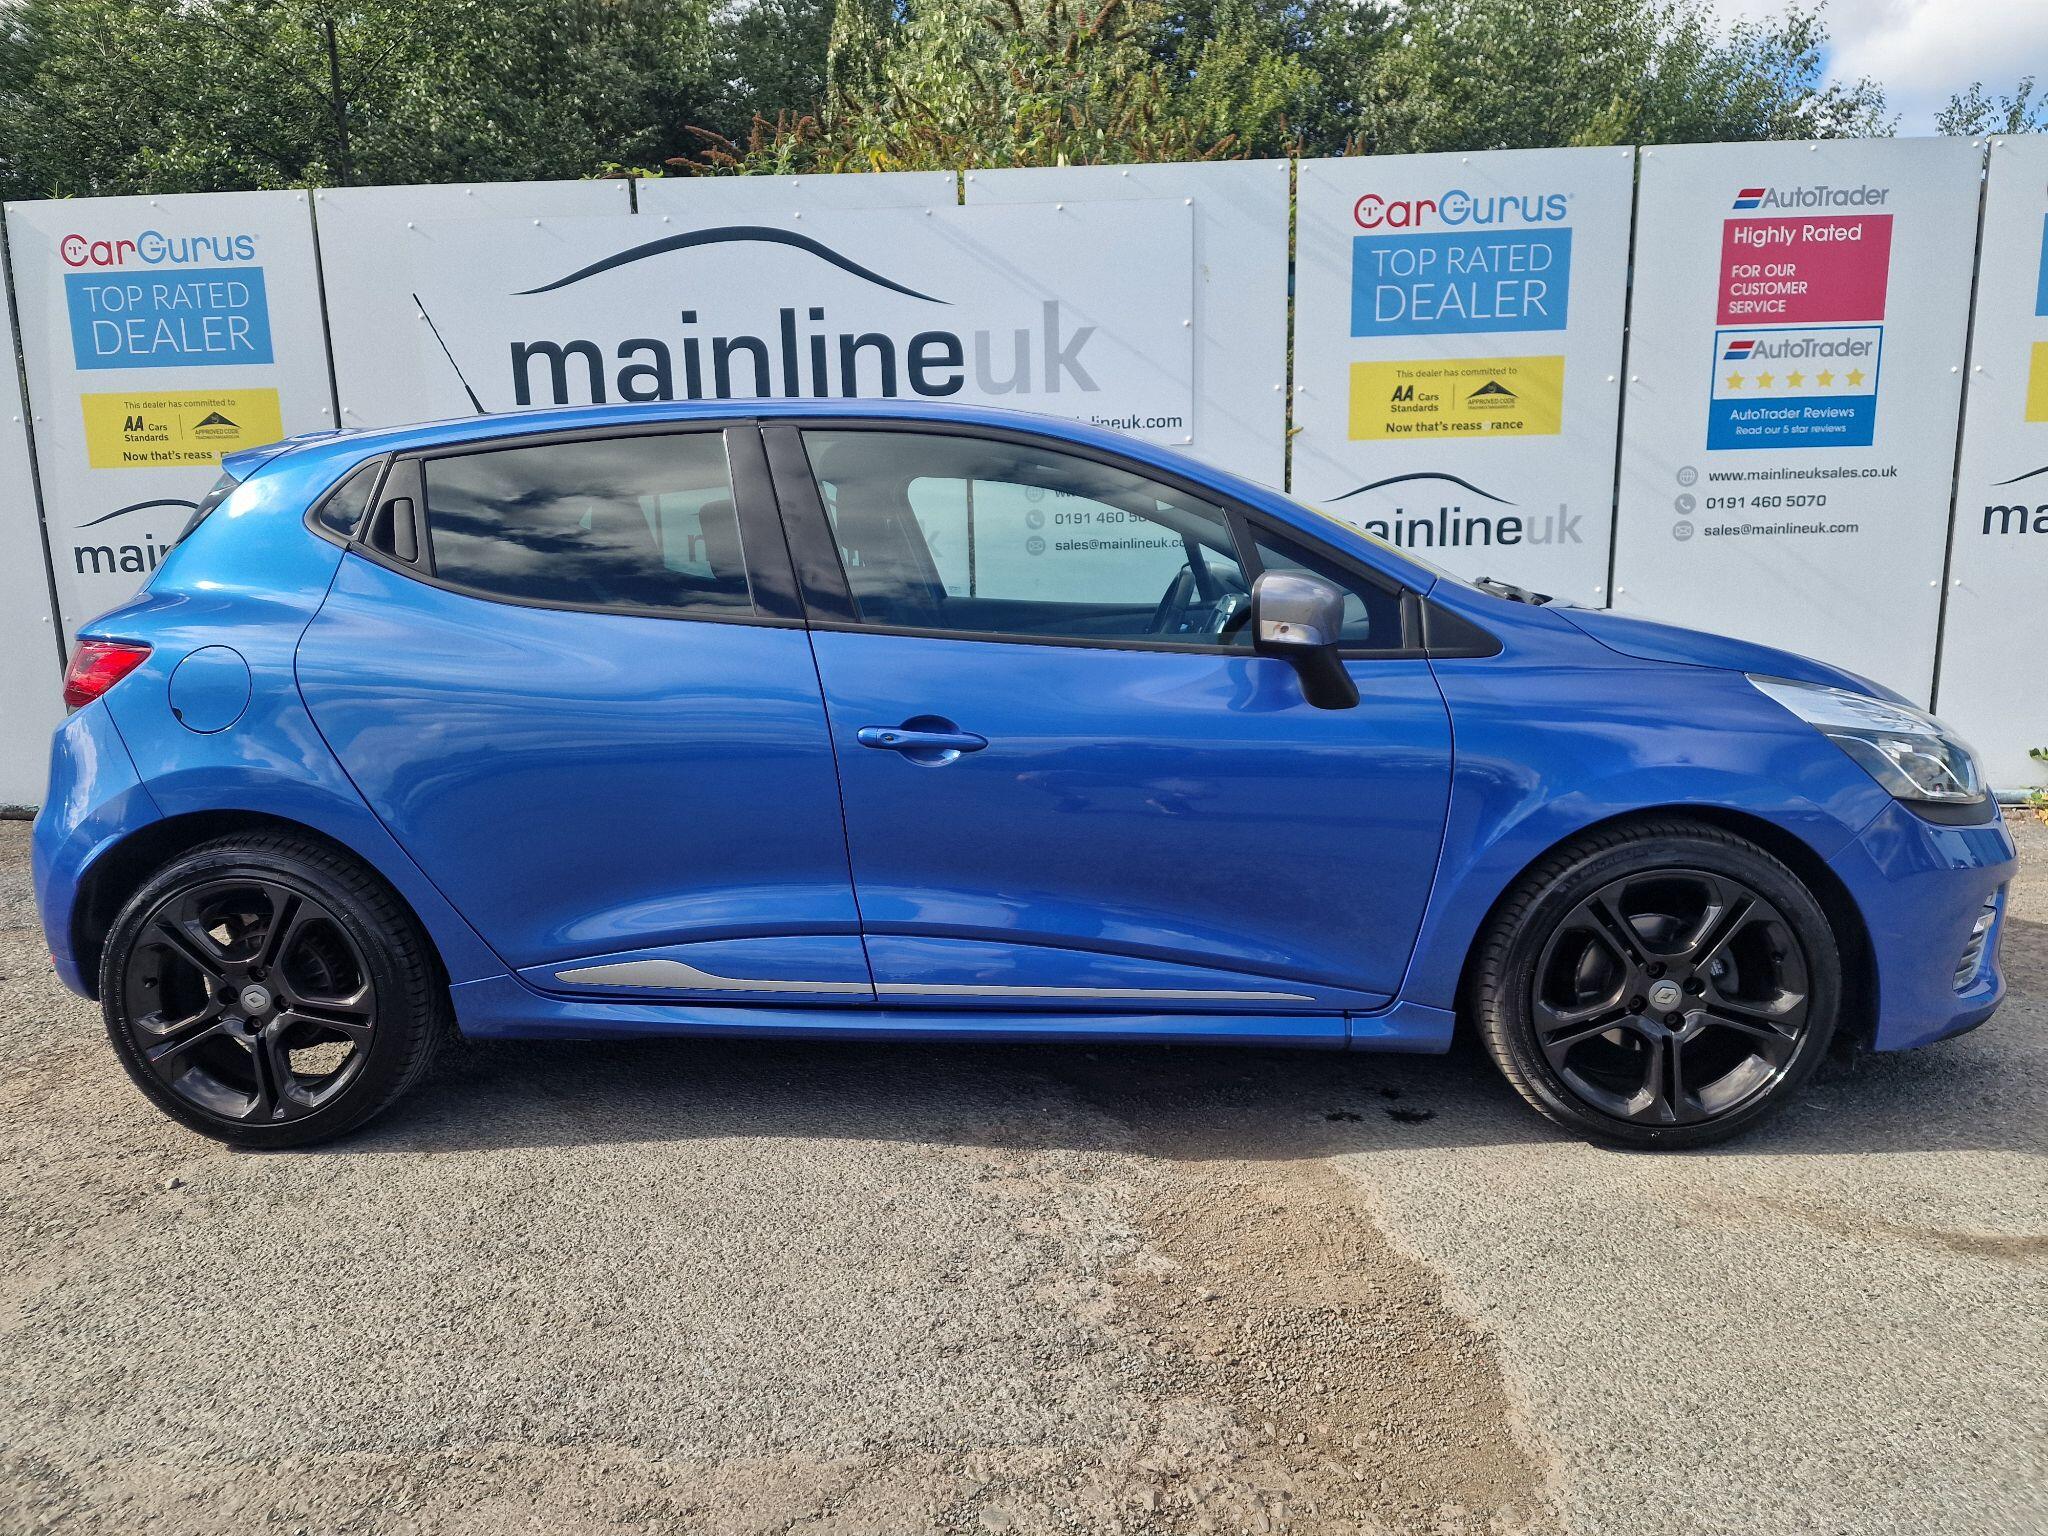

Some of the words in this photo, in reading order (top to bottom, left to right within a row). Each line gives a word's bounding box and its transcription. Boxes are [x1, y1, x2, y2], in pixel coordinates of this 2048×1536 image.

[1762, 185, 1890, 208] AutoTrader
[1353, 189, 1568, 229] CarGurus
[1733, 226, 1797, 248] Highly
[1802, 223, 1862, 242] Rated
[60, 230, 256, 267] CarGurus
[1371, 248, 1437, 277] TOP
[1447, 243, 1553, 274] RATED
[1731, 264, 1760, 278] FOR
[1764, 263, 1796, 277] OUR
[83, 285, 143, 312] TOP
[152, 281, 249, 310] RATED
[1730, 281, 1808, 296] CUSTOMER
[1375, 279, 1548, 322] DEALER
[1728, 299, 1786, 314] SERVICE
[92, 315, 255, 355] DEALER
[510, 300, 1100, 405] mainlineuk
[1751, 338, 1873, 360] AutoTrader
[1396, 370, 1415, 379] This
[1415, 369, 1442, 378] dealer
[1444, 368, 1459, 377] has
[1460, 367, 1506, 376] committed
[1508, 367, 1518, 375] to
[1391, 384, 1414, 402] AA
[1418, 392, 1439, 401] Cars
[124, 401, 141, 410] This
[142, 401, 166, 409] dealer
[168, 400, 182, 408] has
[184, 399, 226, 408] committed
[227, 399, 236, 407] to
[1390, 403, 1439, 413] Standards
[1730, 408, 1801, 421] AutoTrader
[1803, 407, 1855, 418] Reviews
[123, 415, 144, 432] AA
[148, 423, 168, 432] Cars
[1385, 422, 1413, 433] Now
[1416, 421, 1449, 432] that's
[1735, 426, 1762, 435] Read
[1764, 426, 1780, 435] our
[1783, 425, 1790, 434] 5
[1791, 424, 1809, 434] star
[1811, 424, 1847, 433] reviews
[124, 433, 169, 443] Standards
[123, 451, 149, 462] Now
[150, 450, 181, 461] that's
[1708, 465, 1898, 482] www.mainlineuksales.co.uk
[1706, 496, 1746, 509] 0191
[1750, 495, 1782, 508] 460
[1786, 494, 1827, 507] 5070
[1055, 513, 1091, 525] 0191
[1096, 512, 1124, 523] 460
[1350, 503, 1583, 547] ainlineuk
[1704, 521, 1859, 537] sales@mainlineuk.com
